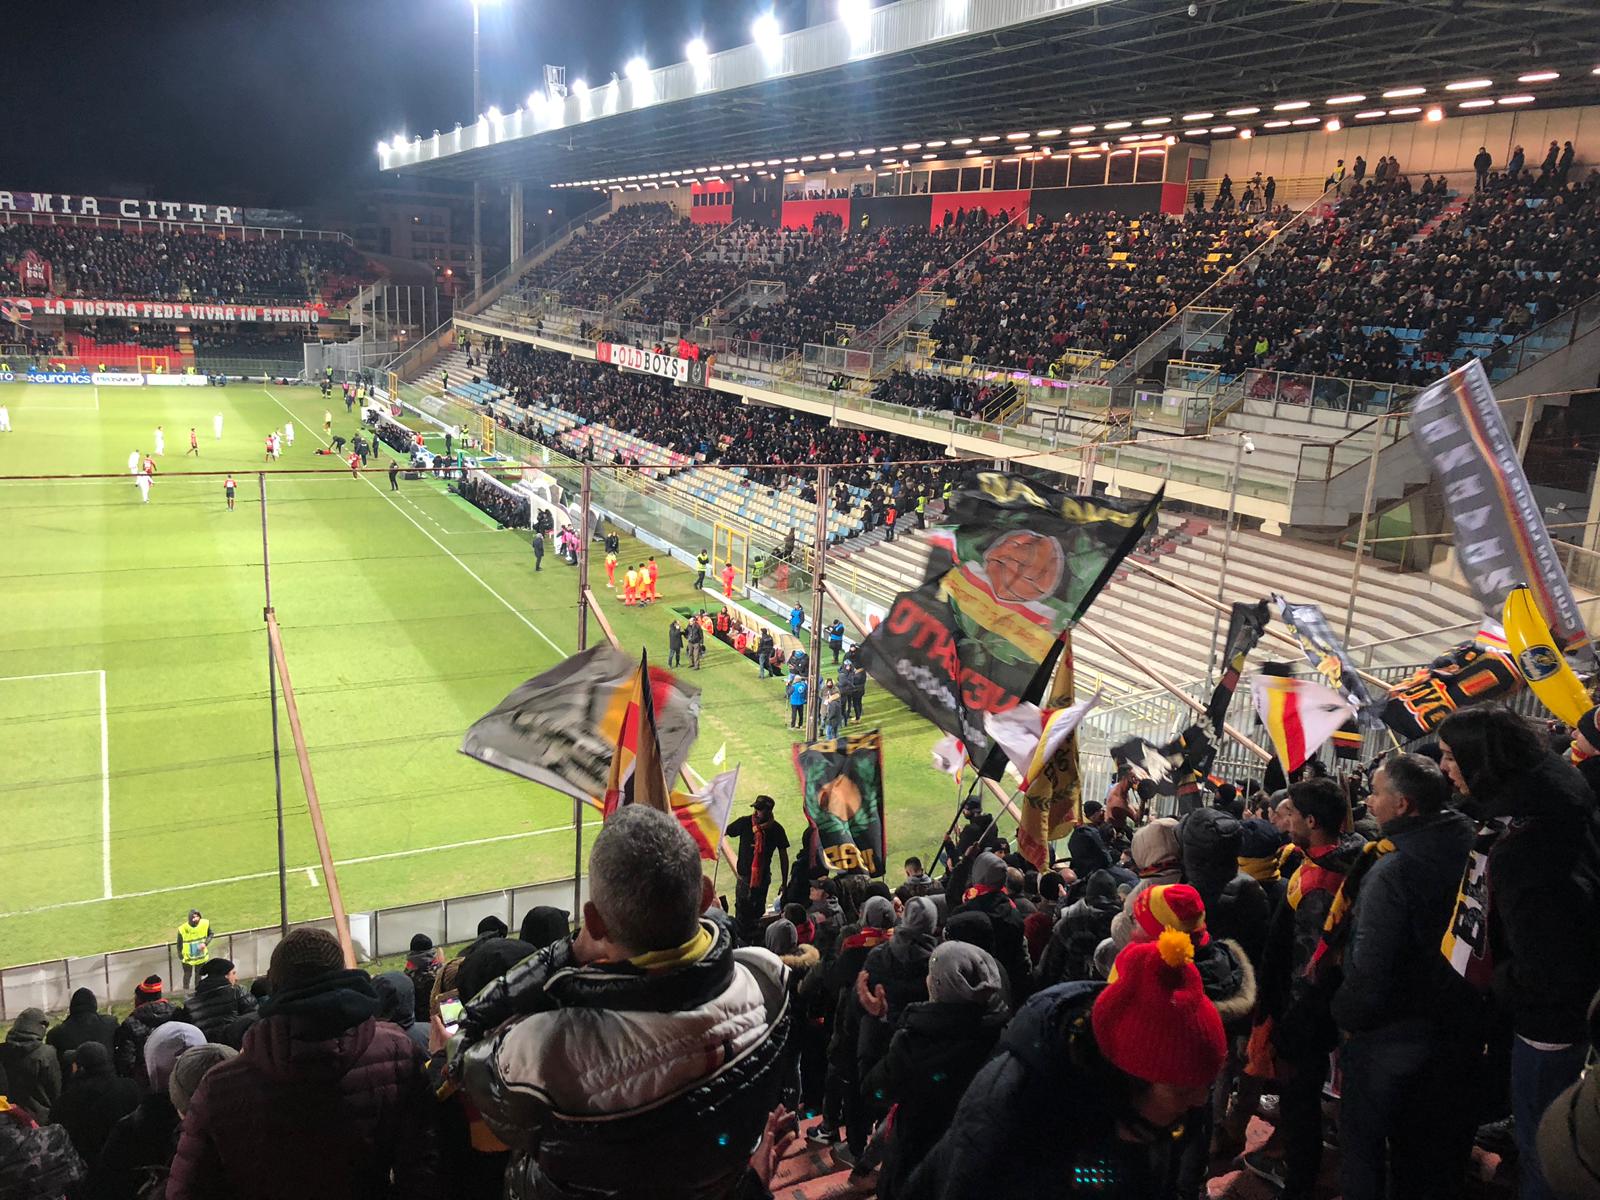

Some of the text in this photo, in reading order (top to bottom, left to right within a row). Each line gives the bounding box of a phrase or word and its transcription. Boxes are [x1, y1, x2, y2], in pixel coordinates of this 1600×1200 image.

[31, 193, 100, 215] MIA
[44, 300, 66, 315] LA
[73, 301, 138, 318] NOSTRA
[143, 304, 184, 319] FEDE
[240, 308, 257, 322] IN
[263, 309, 320, 323] ETERNO
[35, 373, 92, 384] euronics
